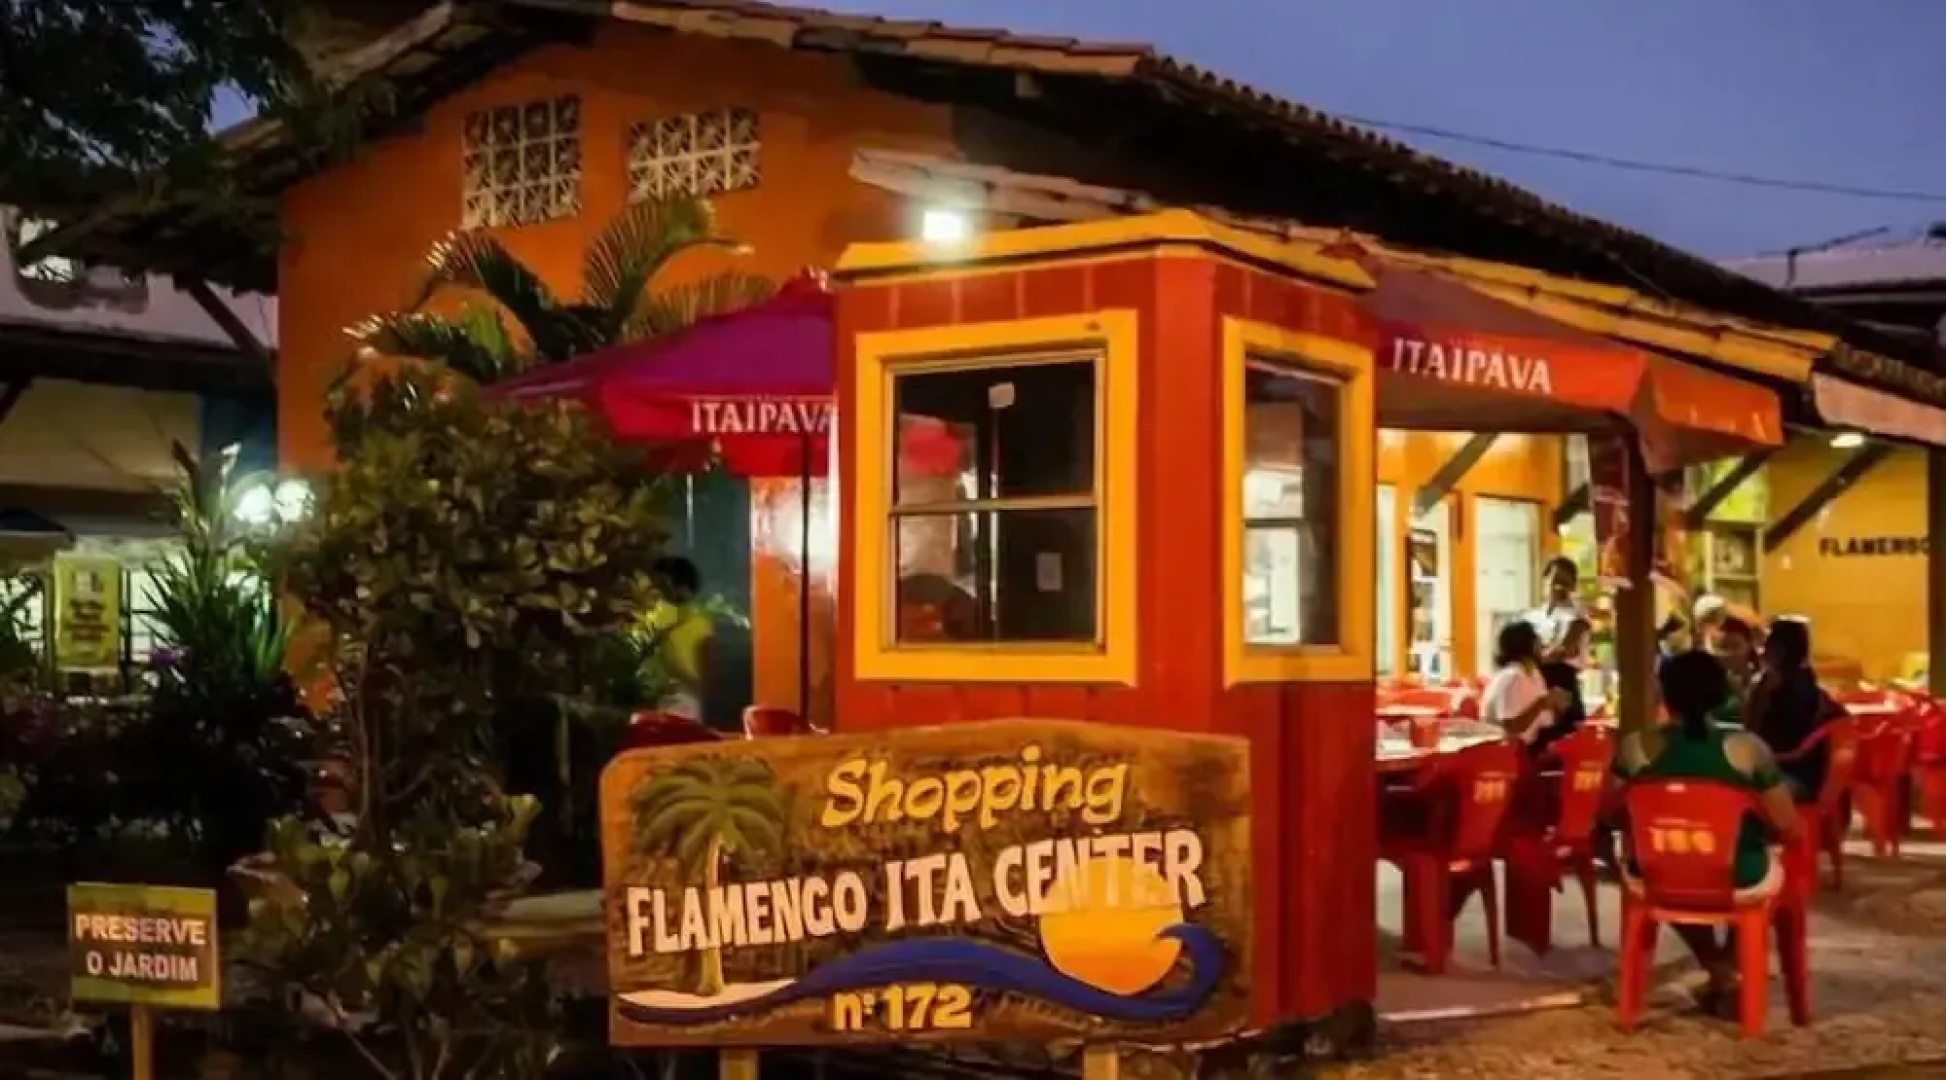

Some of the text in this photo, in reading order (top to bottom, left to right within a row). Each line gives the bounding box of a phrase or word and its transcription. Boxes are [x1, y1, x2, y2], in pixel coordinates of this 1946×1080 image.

[1393, 337, 1551, 395] ITAIPAVA
[822, 745, 1127, 833] Shopping
[627, 829, 1205, 956] FLAMENGO ITA CENTER
[75, 914, 206, 945] PRESERVE
[86, 951, 198, 982] O JARDIM
[883, 982, 972, 1029] 172
